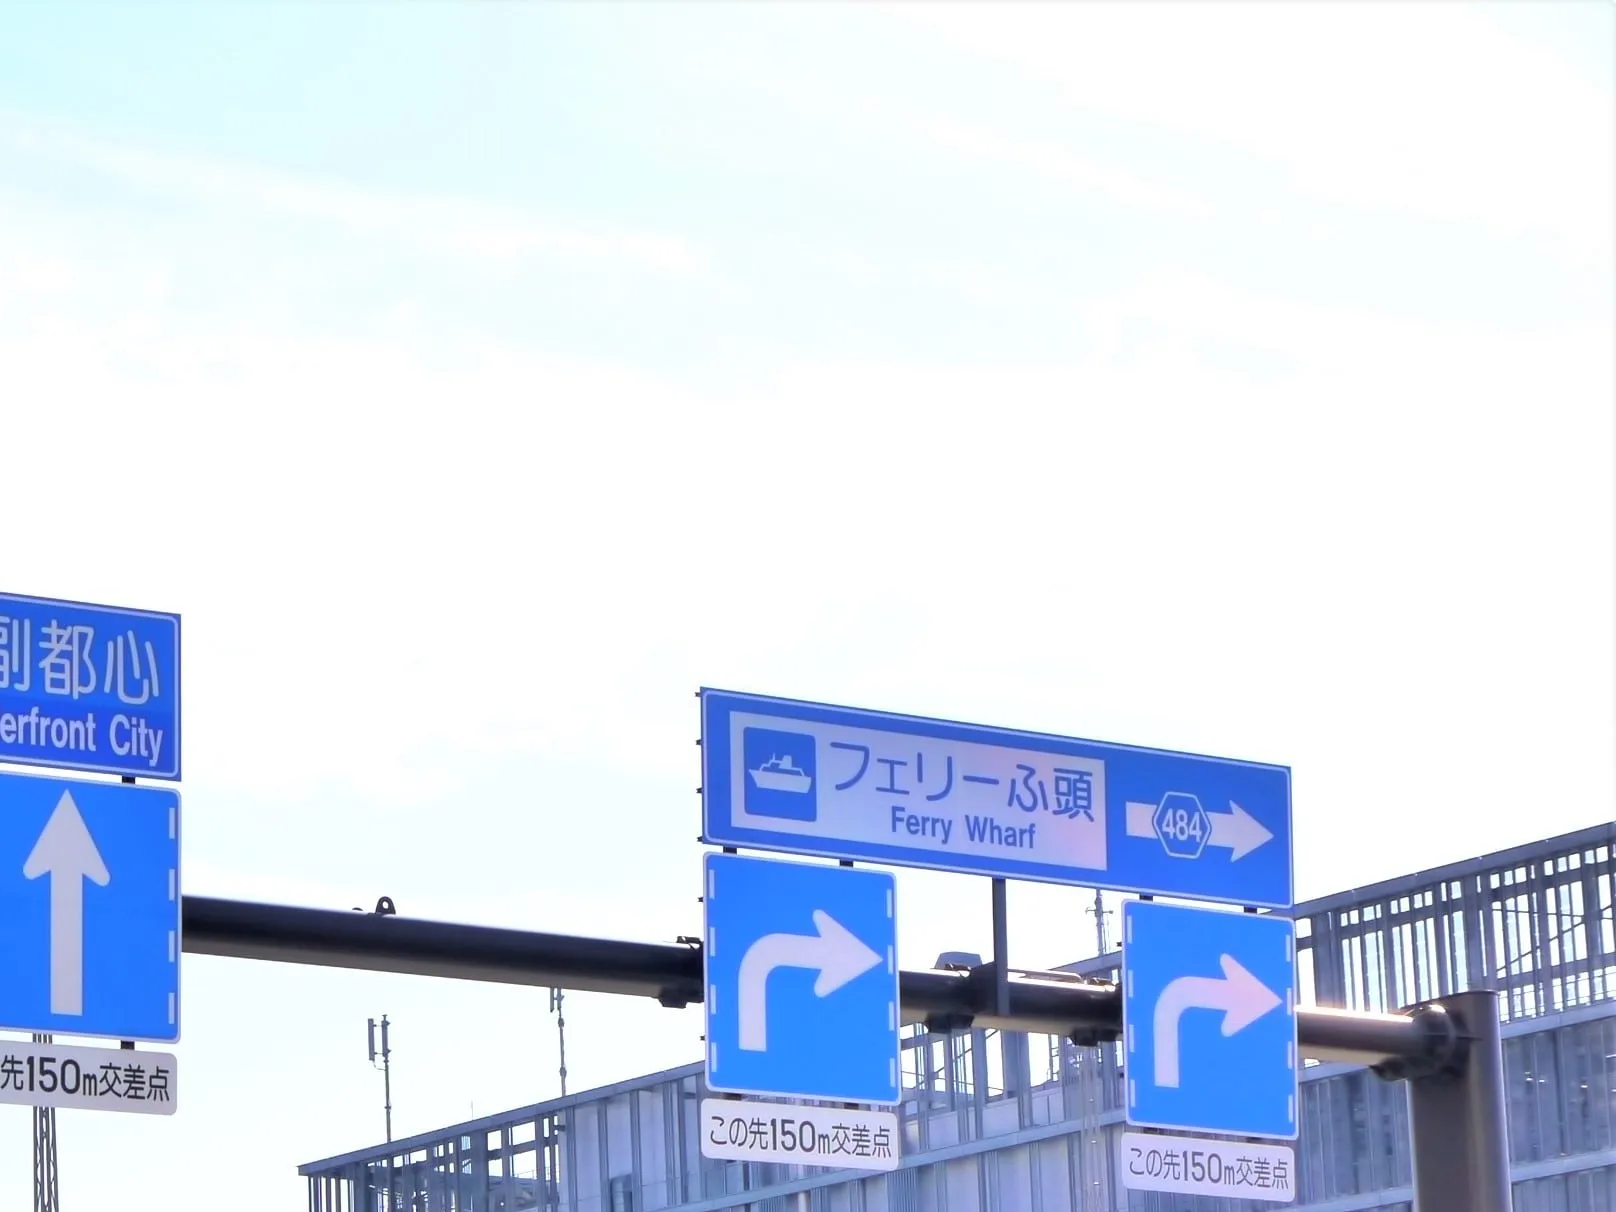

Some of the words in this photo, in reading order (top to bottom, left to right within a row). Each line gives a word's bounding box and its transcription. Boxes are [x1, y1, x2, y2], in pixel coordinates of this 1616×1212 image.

[109, 713, 163, 767] City
[829, 741, 1095, 823] フェリーふ頭
[890, 805, 953, 845] Ferry
[965, 815, 1036, 849] Wharf
[1161, 809, 1203, 843] 484
[708, 1114, 892, 1159] この先150m交差点
[1128, 1146, 1289, 1191] この先150m交差点
